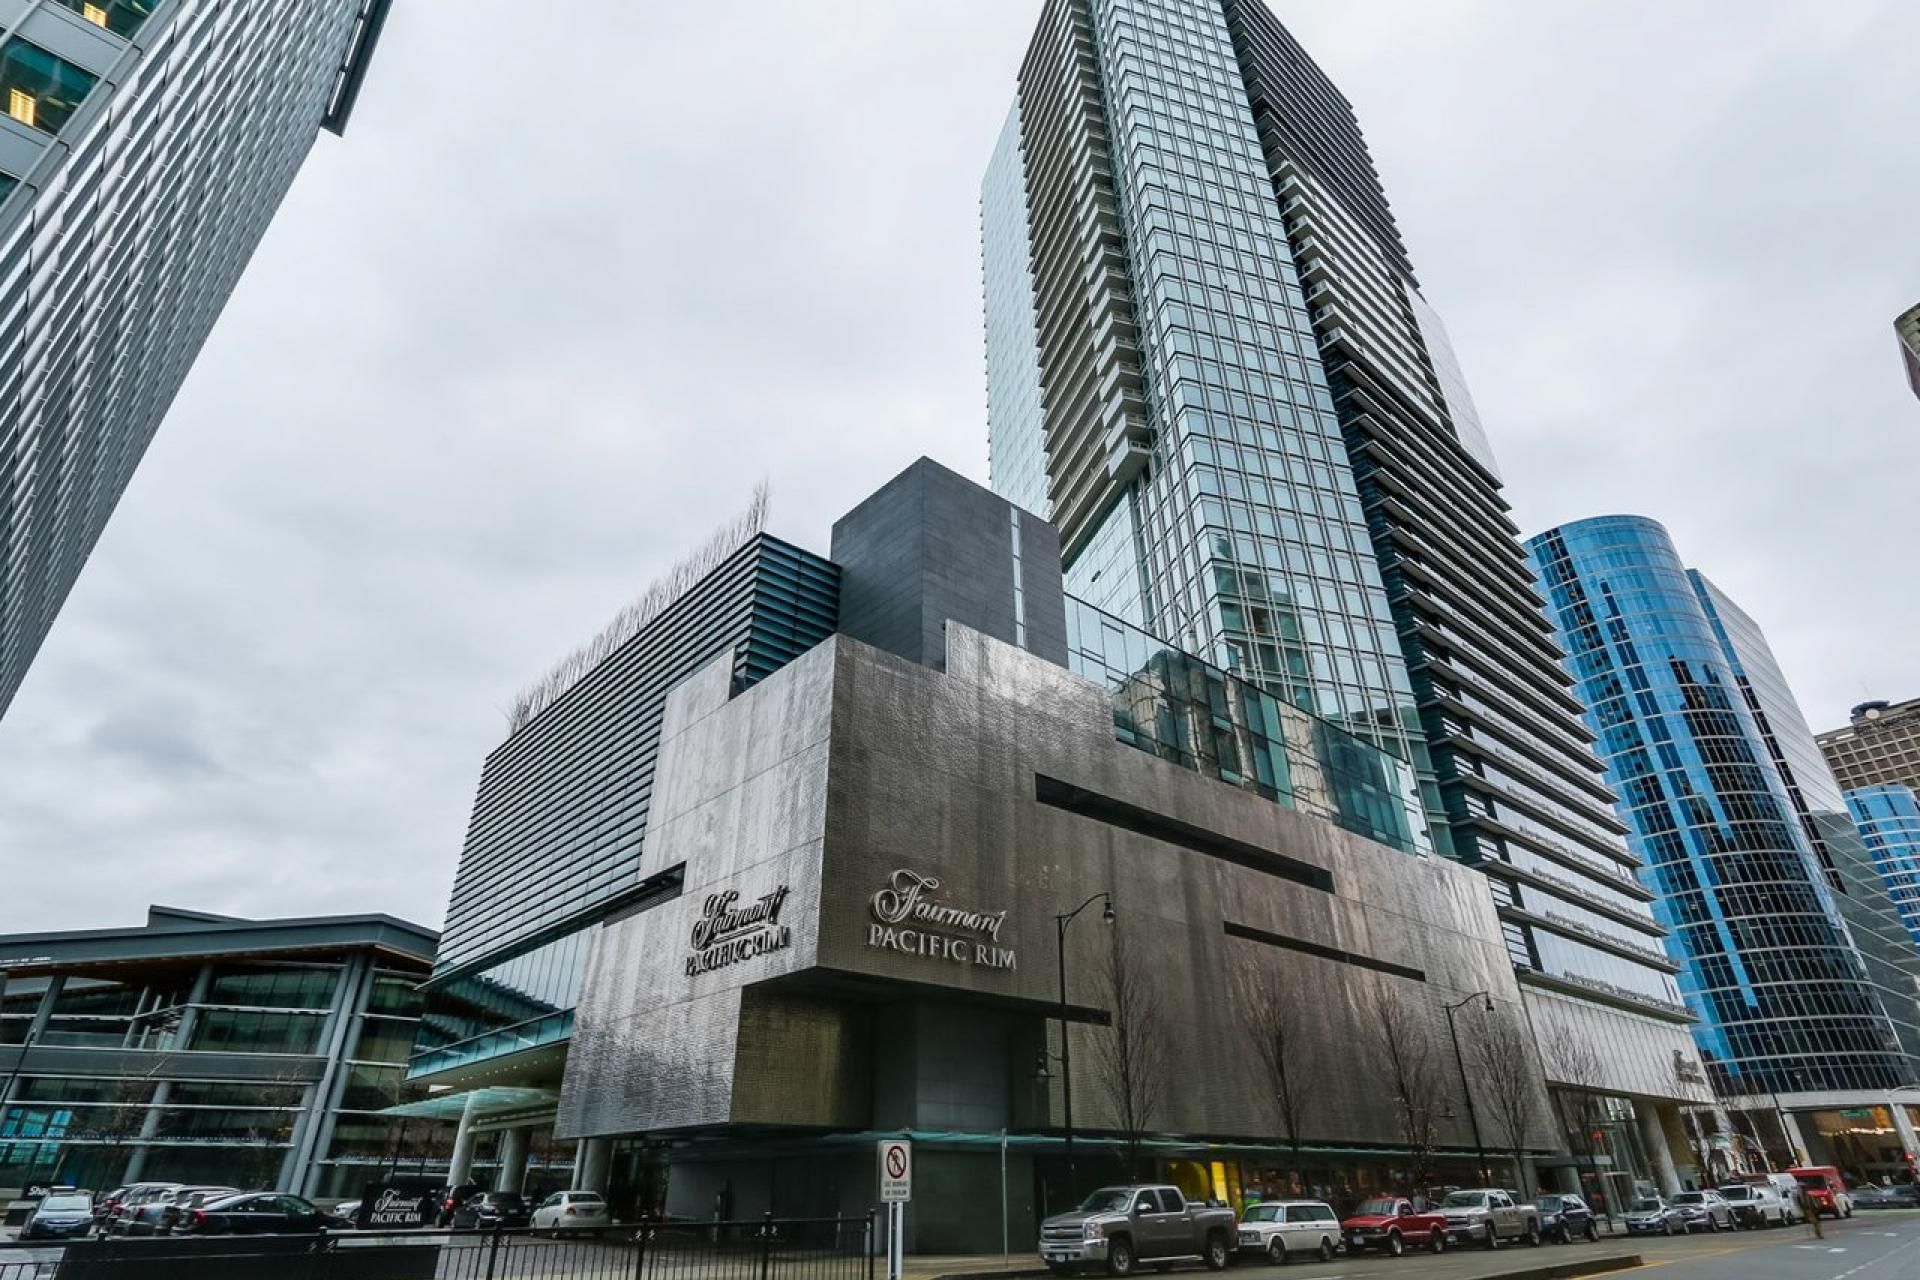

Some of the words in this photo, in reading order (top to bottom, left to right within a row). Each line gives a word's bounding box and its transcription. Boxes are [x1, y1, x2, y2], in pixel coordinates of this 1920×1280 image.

[690, 885, 789, 952] Fairmont
[871, 869, 1007, 943] Fairmont
[685, 938, 752, 977] PACIFIC
[752, 926, 791, 957] RIM
[867, 923, 968, 961] PACIFIC
[975, 944, 1017, 970] RIM
[370, 1211, 404, 1223] PACIFIC
